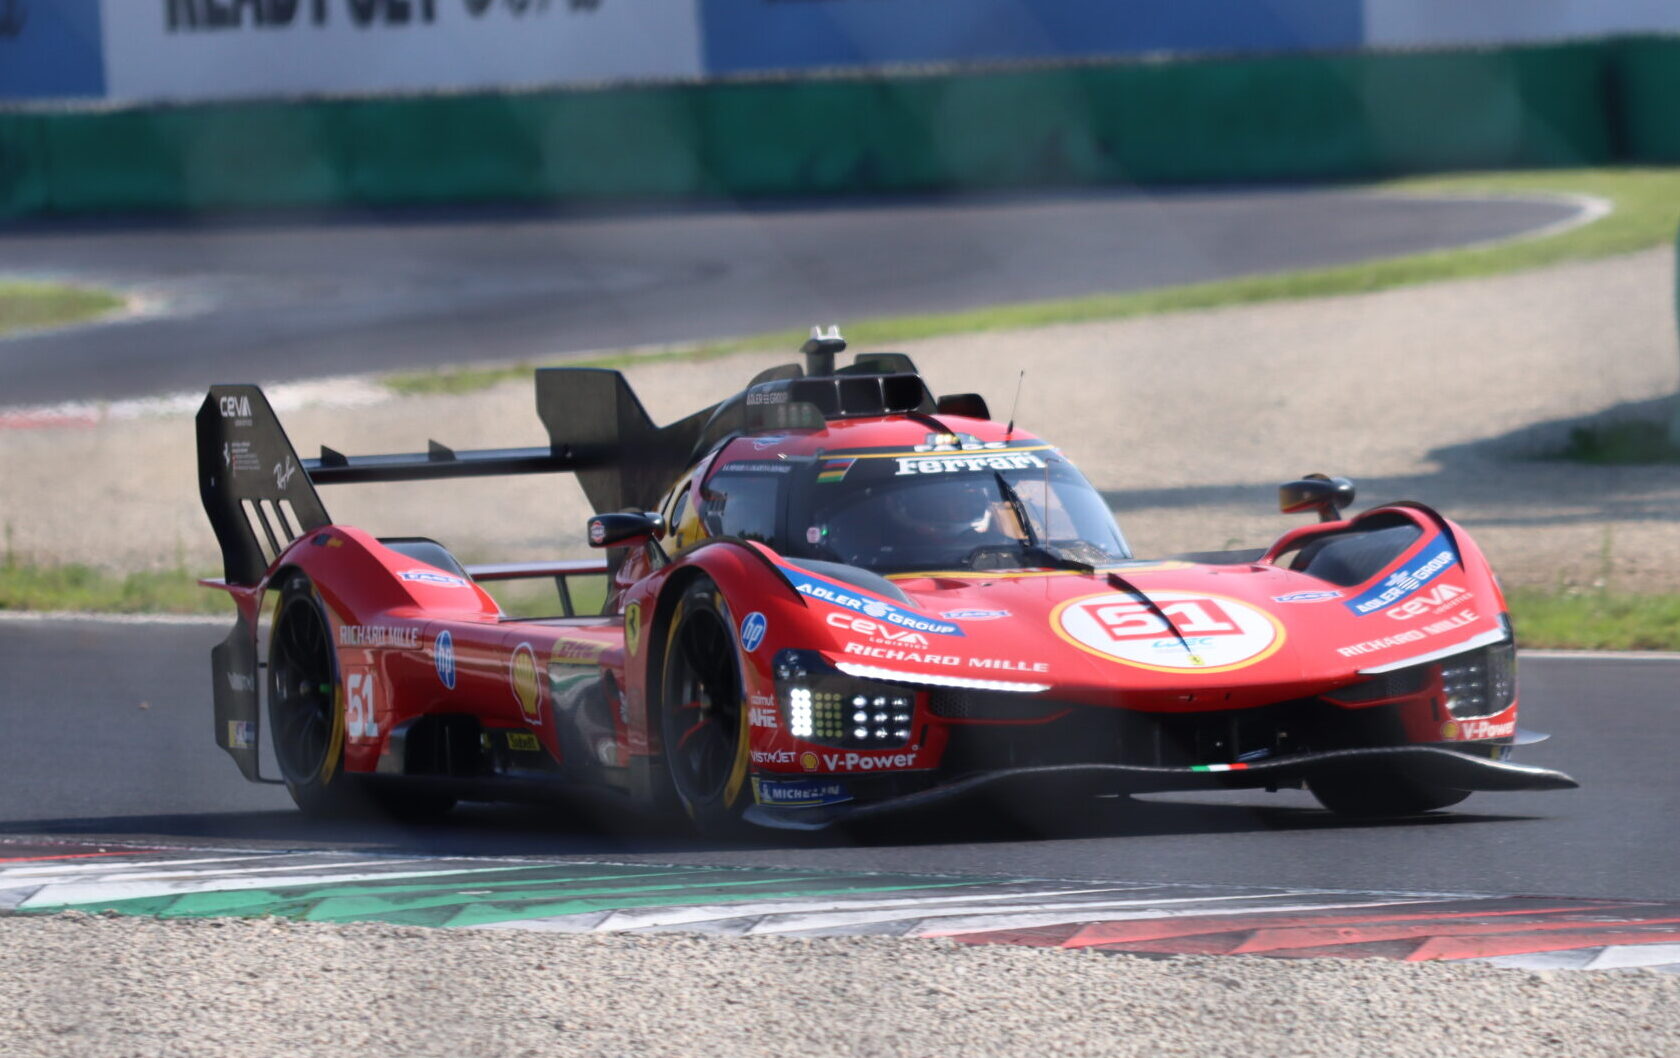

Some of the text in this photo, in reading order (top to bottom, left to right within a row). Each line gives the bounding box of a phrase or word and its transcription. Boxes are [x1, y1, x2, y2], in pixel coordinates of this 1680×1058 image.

[220, 396, 252, 417] CEVA
[895, 451, 1048, 475] Ferrari
[1355, 551, 1454, 613] ADLER GROUP
[795, 583, 956, 633] ADLER GROUP
[1386, 584, 1466, 620] CEVA
[340, 625, 418, 647] RICHARD MILLE
[742, 614, 765, 651] hp
[826, 612, 929, 645] CEVA
[1095, 602, 1234, 637] 51
[1336, 609, 1480, 657] RICHARD MILLE
[843, 642, 1049, 673] RICHARD MILLE
[868, 637, 929, 650] LOGISTICS
[347, 674, 379, 737] 51
[1462, 721, 1515, 739] V-Powe
[822, 753, 916, 771] V-Power
